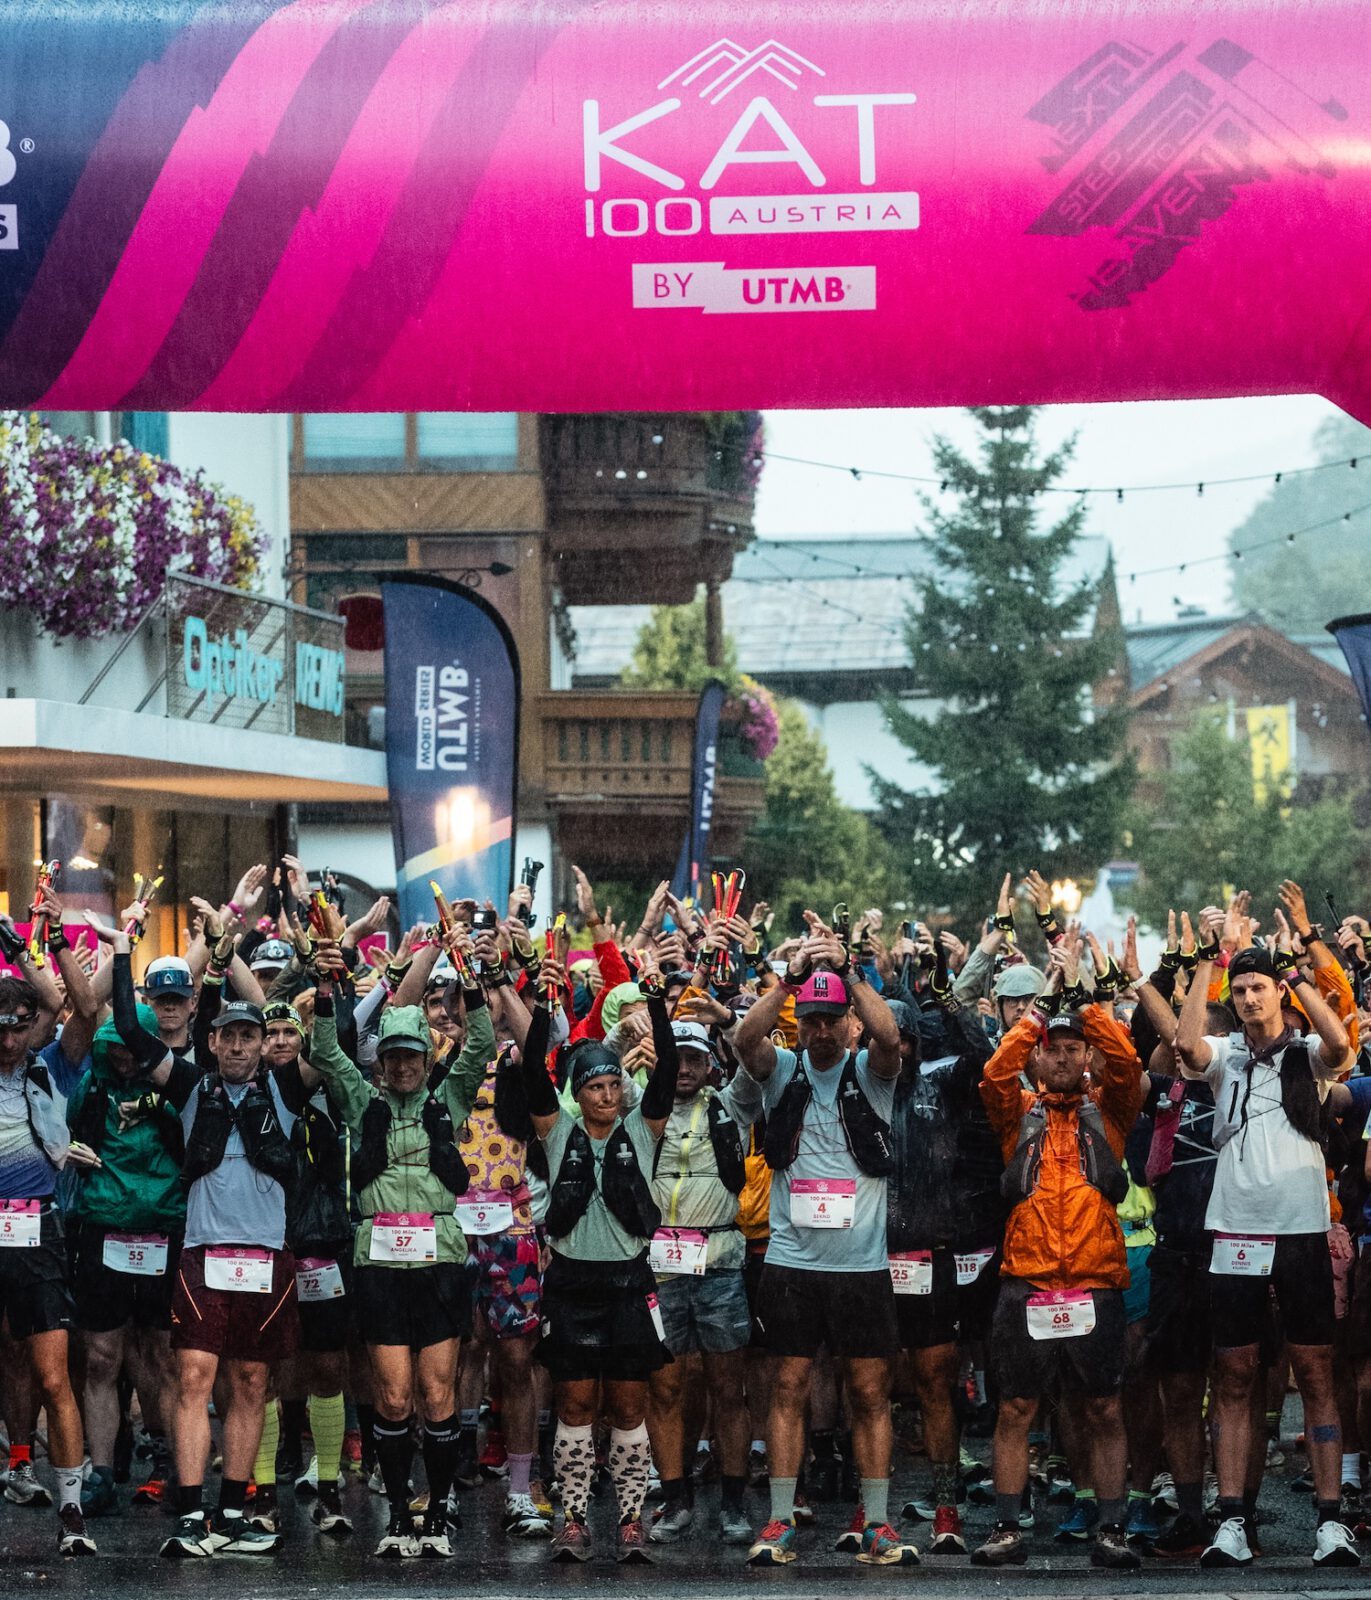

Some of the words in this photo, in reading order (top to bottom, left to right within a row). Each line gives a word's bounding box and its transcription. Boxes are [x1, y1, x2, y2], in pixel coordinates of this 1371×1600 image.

[583, 93, 917, 192] KAT
[1142, 143, 1174, 171] TO
[1059, 150, 1123, 224] STEP
[585, 197, 701, 237] 100
[728, 204, 902, 224] AUSTRIA
[653, 272, 694, 298] BY
[742, 276, 845, 305] UTMB
[184, 615, 283, 712] Optiker
[817, 1203, 826, 1213] 4
[477, 1211, 486, 1222] 9
[3, 1221, 12, 1233] 5
[395, 1236, 412, 1247] 57
[128, 1250, 144, 1261] 55
[666, 1248, 683, 1259] 22
[1237, 1249, 1246, 1260] 6
[235, 1266, 243, 1277] 8
[957, 1262, 977, 1273] 118
[891, 1269, 908, 1280] 25
[303, 1278, 320, 1289] 72
[1053, 1312, 1070, 1324] 68
